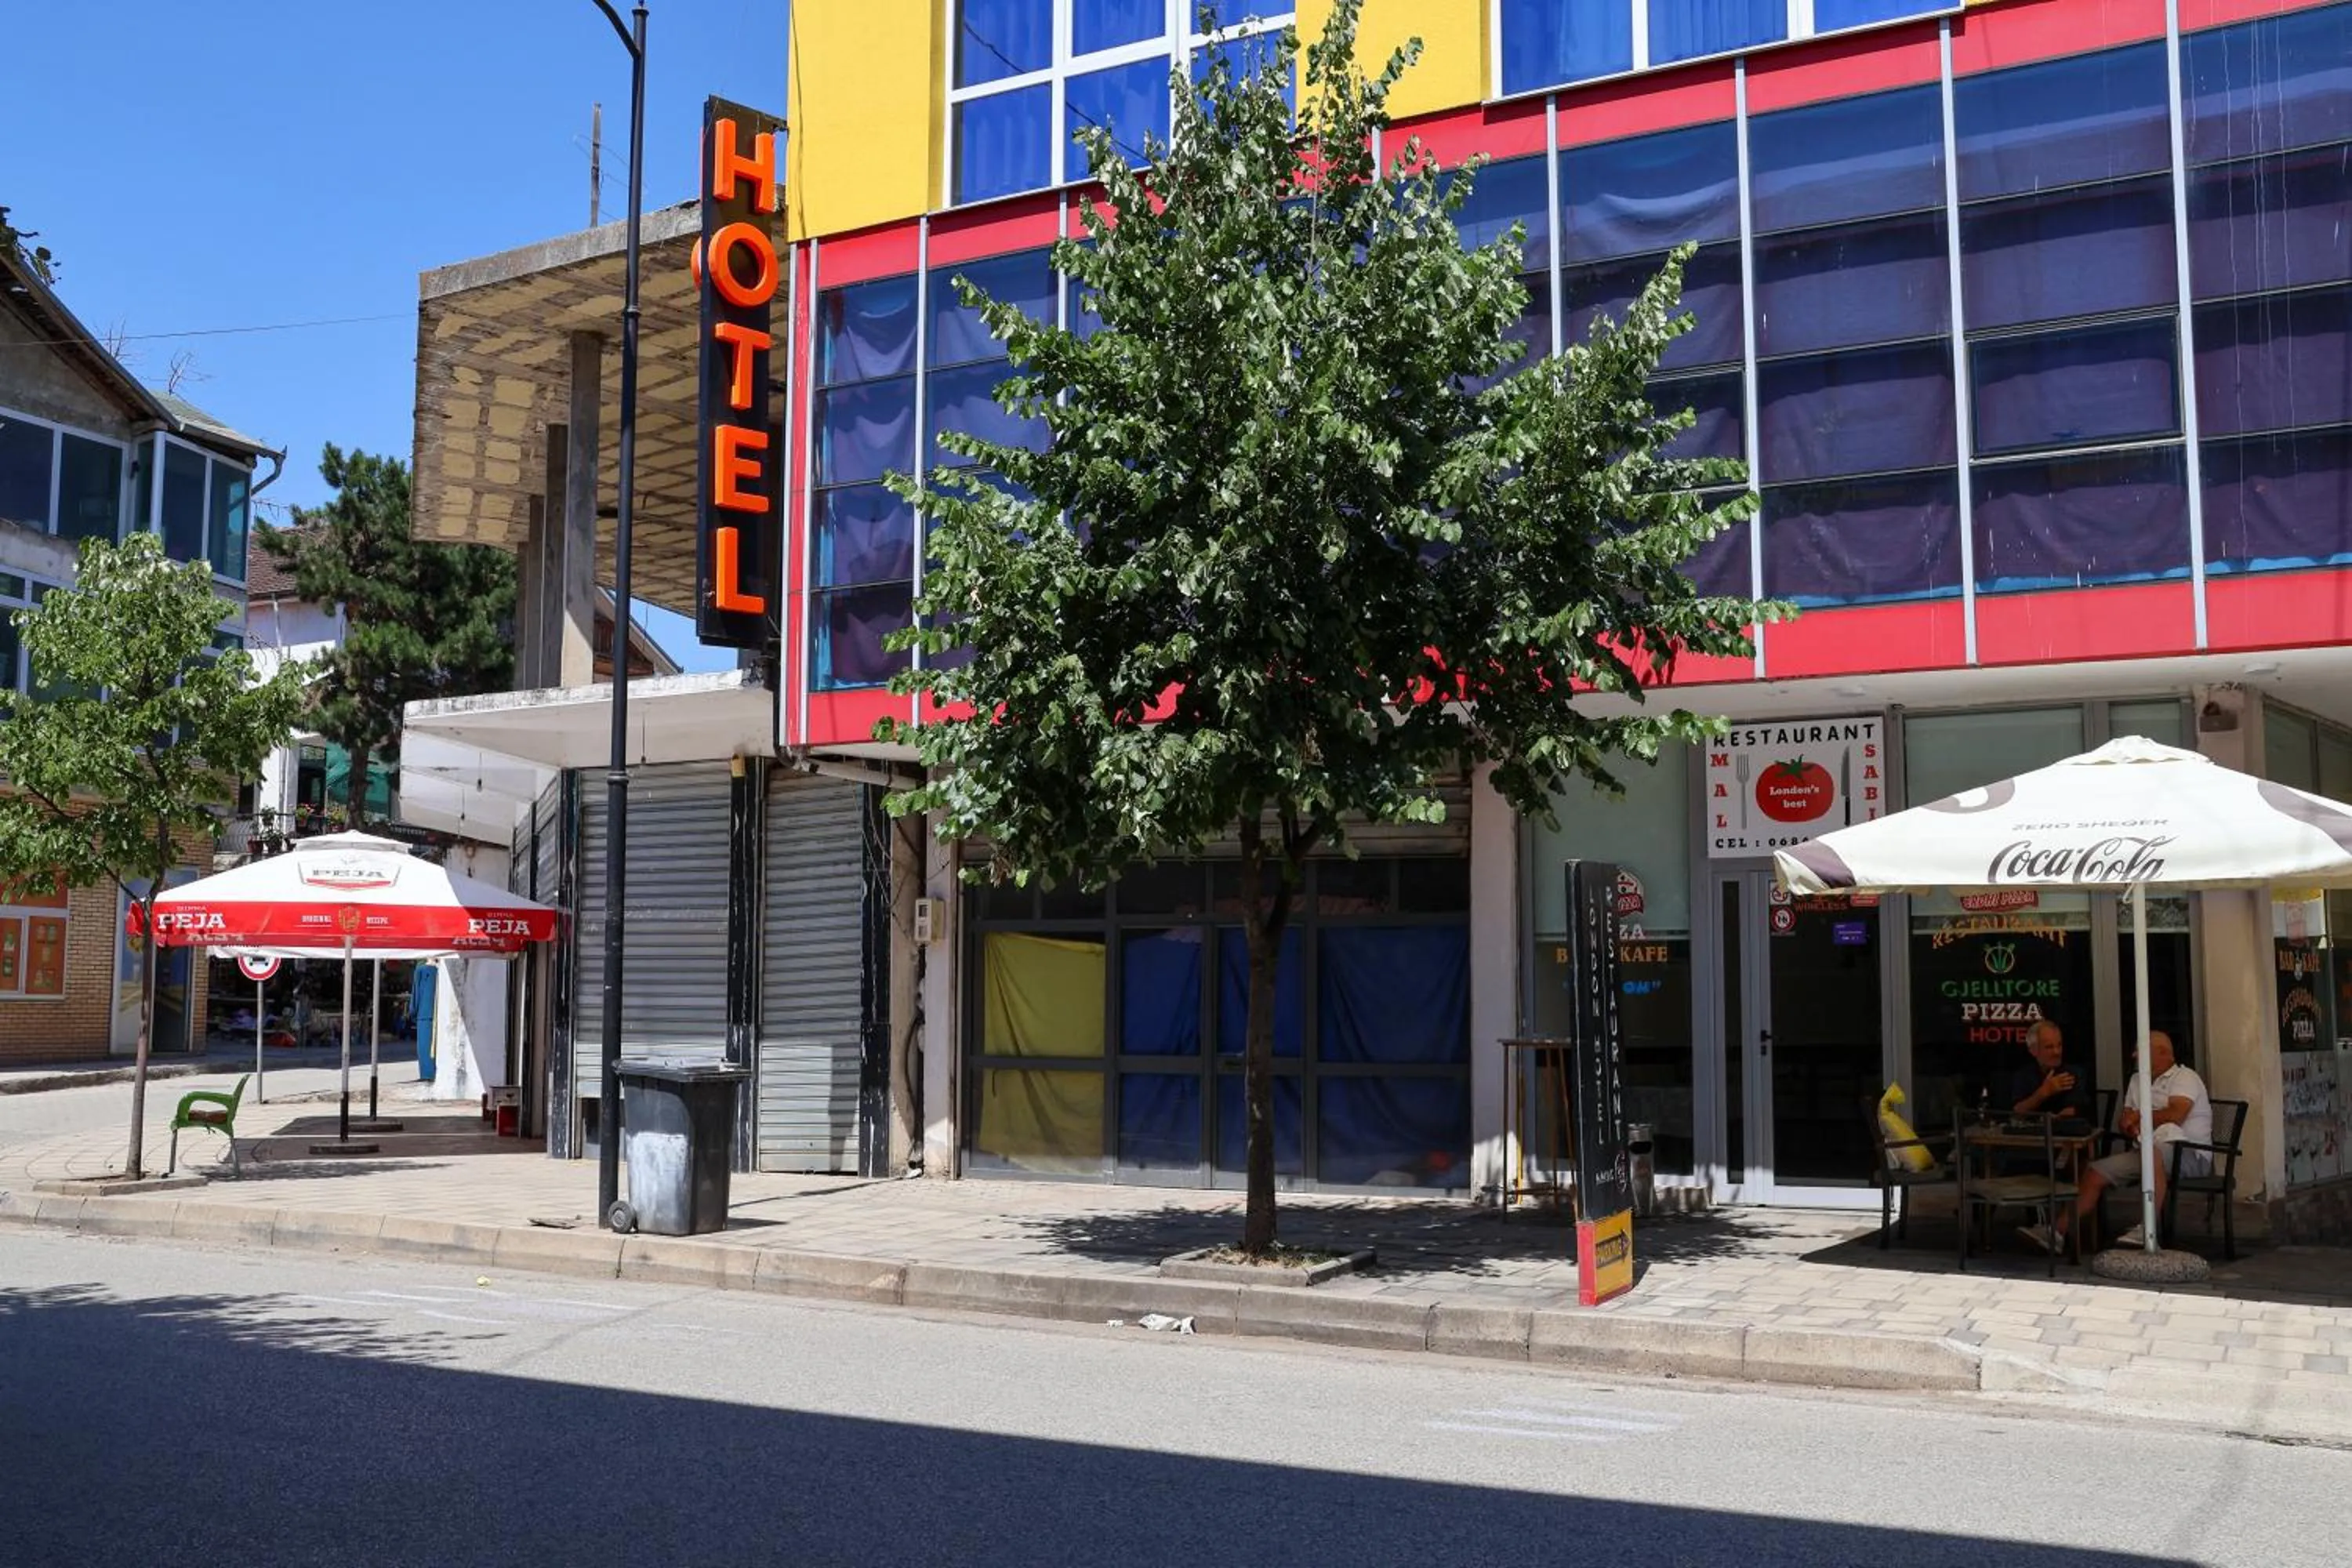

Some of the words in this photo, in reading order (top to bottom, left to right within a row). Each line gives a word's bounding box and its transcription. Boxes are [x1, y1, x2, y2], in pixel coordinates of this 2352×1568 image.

[708, 118, 779, 614] HOTEL
[1713, 724, 1875, 747] RESTAURANT
[1769, 784, 1820, 796] London's
[1782, 799, 1807, 808] best
[157, 913, 227, 929] PEJA
[468, 917, 532, 935] PEJA
[1620, 946, 1668, 963] KAFE
[1606, 885, 1622, 1141] RESTAURANT
[1962, 1002, 2043, 1020] PIZZA
[1969, 1025, 2027, 1043] HOTE
